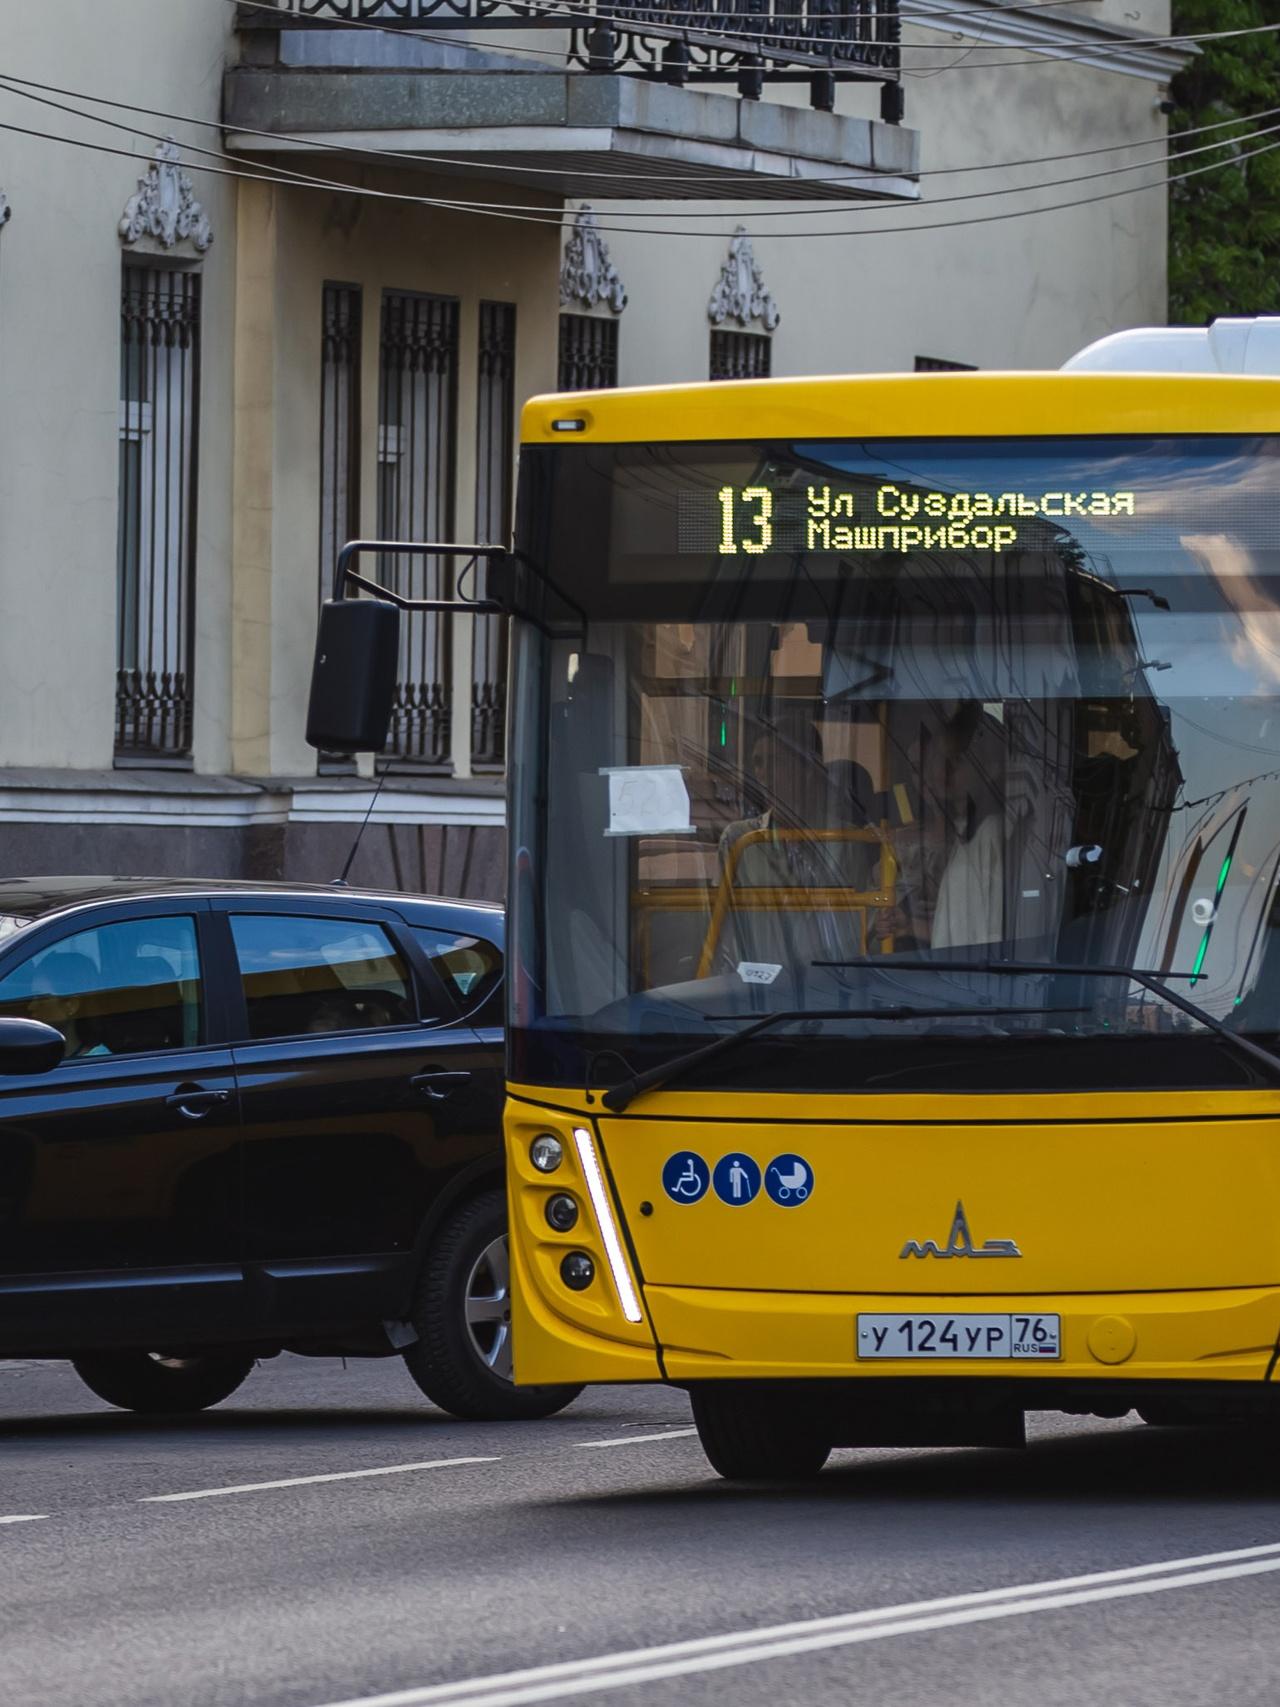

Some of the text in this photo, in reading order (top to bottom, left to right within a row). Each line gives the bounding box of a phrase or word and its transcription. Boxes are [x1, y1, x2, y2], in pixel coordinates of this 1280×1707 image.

[718, 486, 775, 554] 13
[807, 486, 1136, 521] Ул Суздальская
[807, 518, 1018, 553] Машприбор
[1014, 1343, 1038, 1353] RUS
[1015, 1318, 1048, 1343] 76
